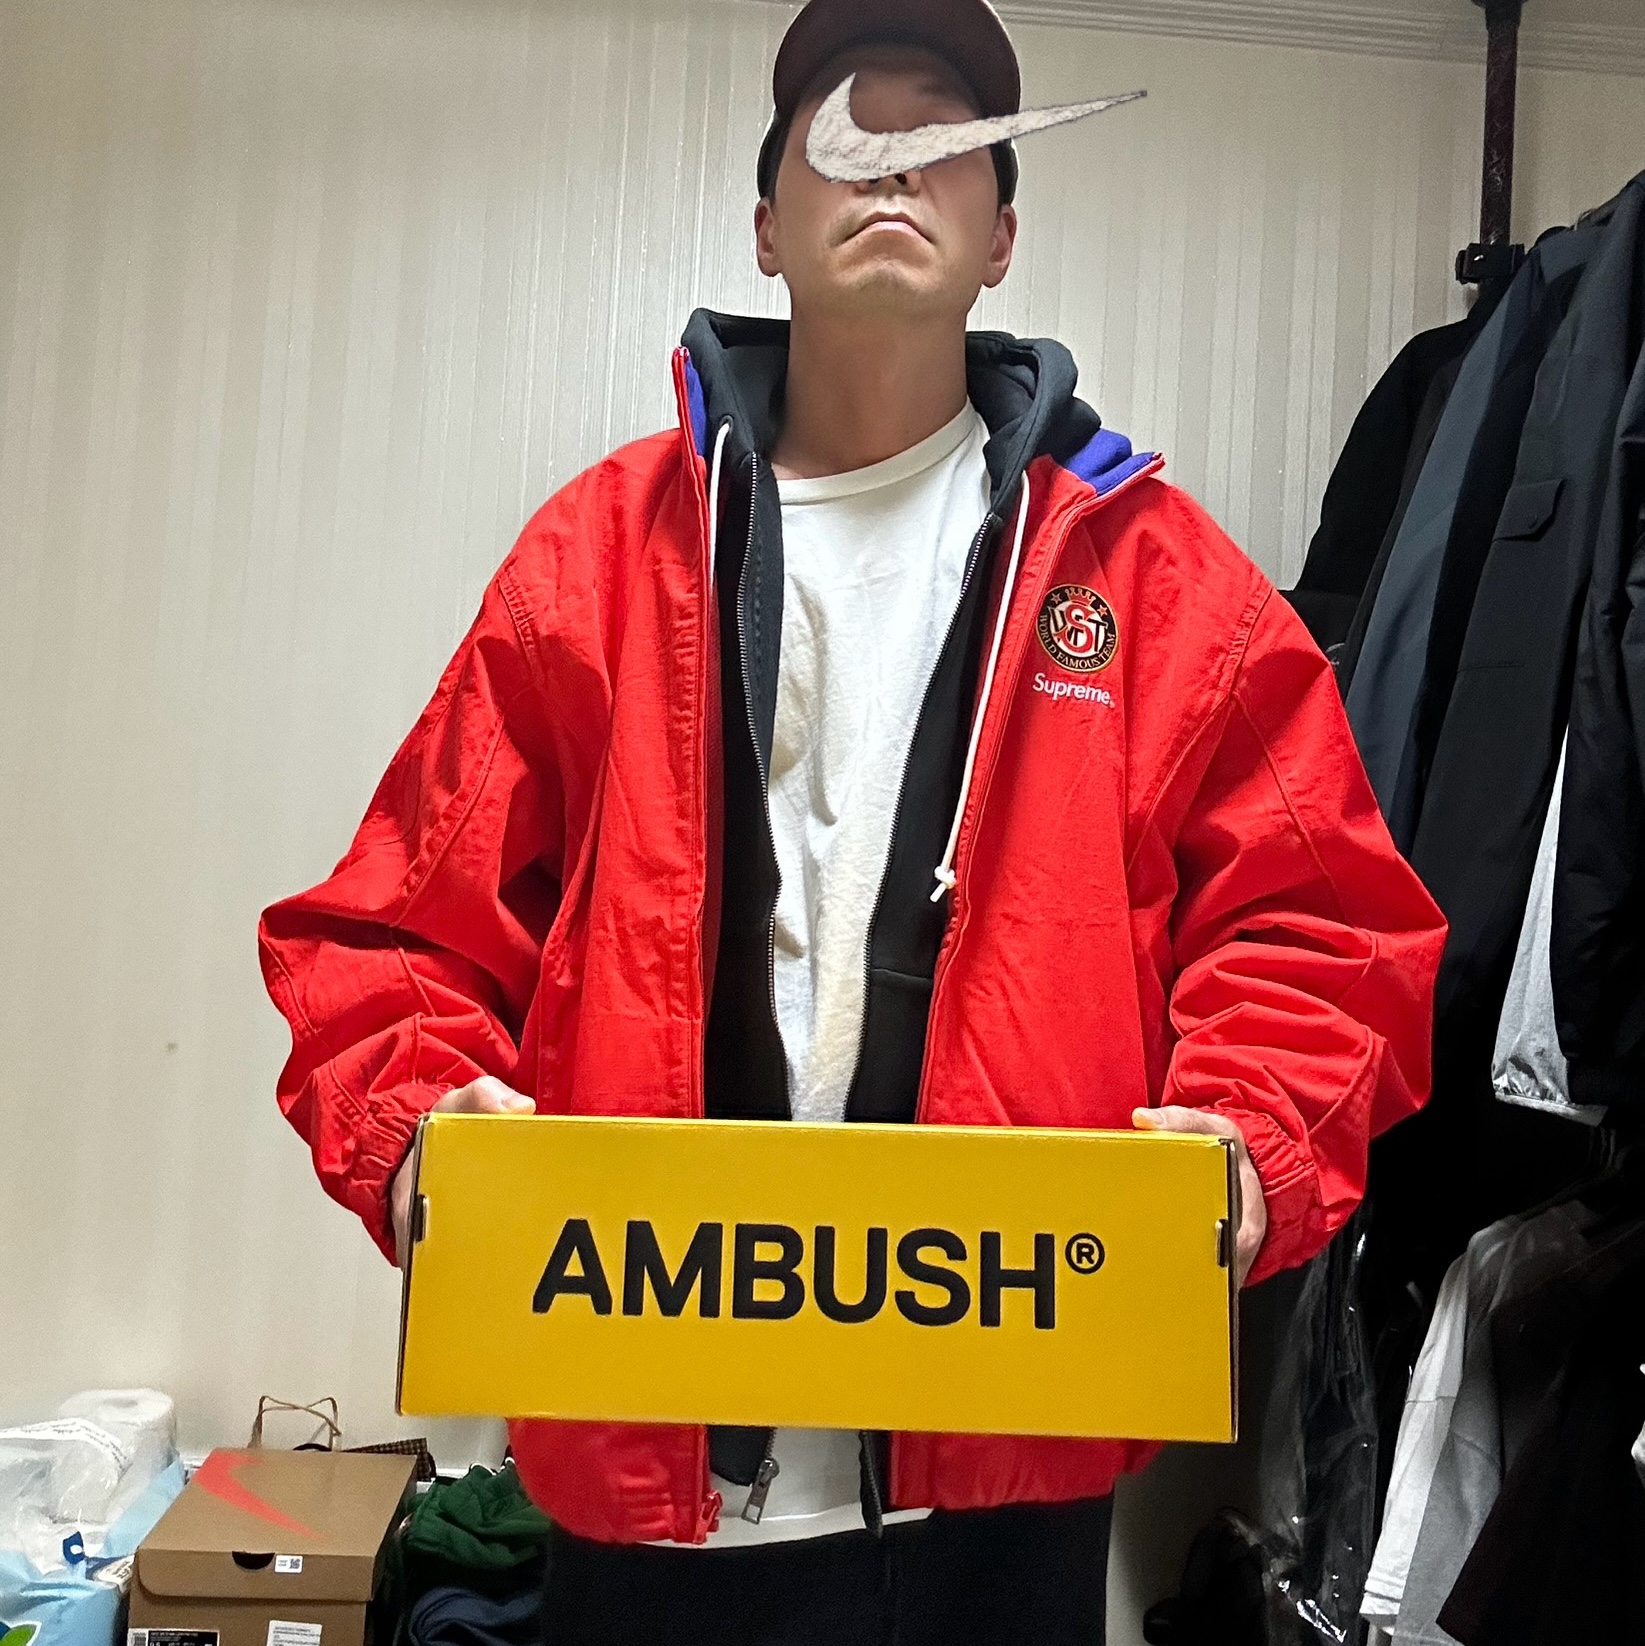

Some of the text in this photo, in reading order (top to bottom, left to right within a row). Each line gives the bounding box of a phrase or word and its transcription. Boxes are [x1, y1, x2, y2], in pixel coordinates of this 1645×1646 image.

[1039, 614, 1116, 669] WORLD FAMOUS TEAM
